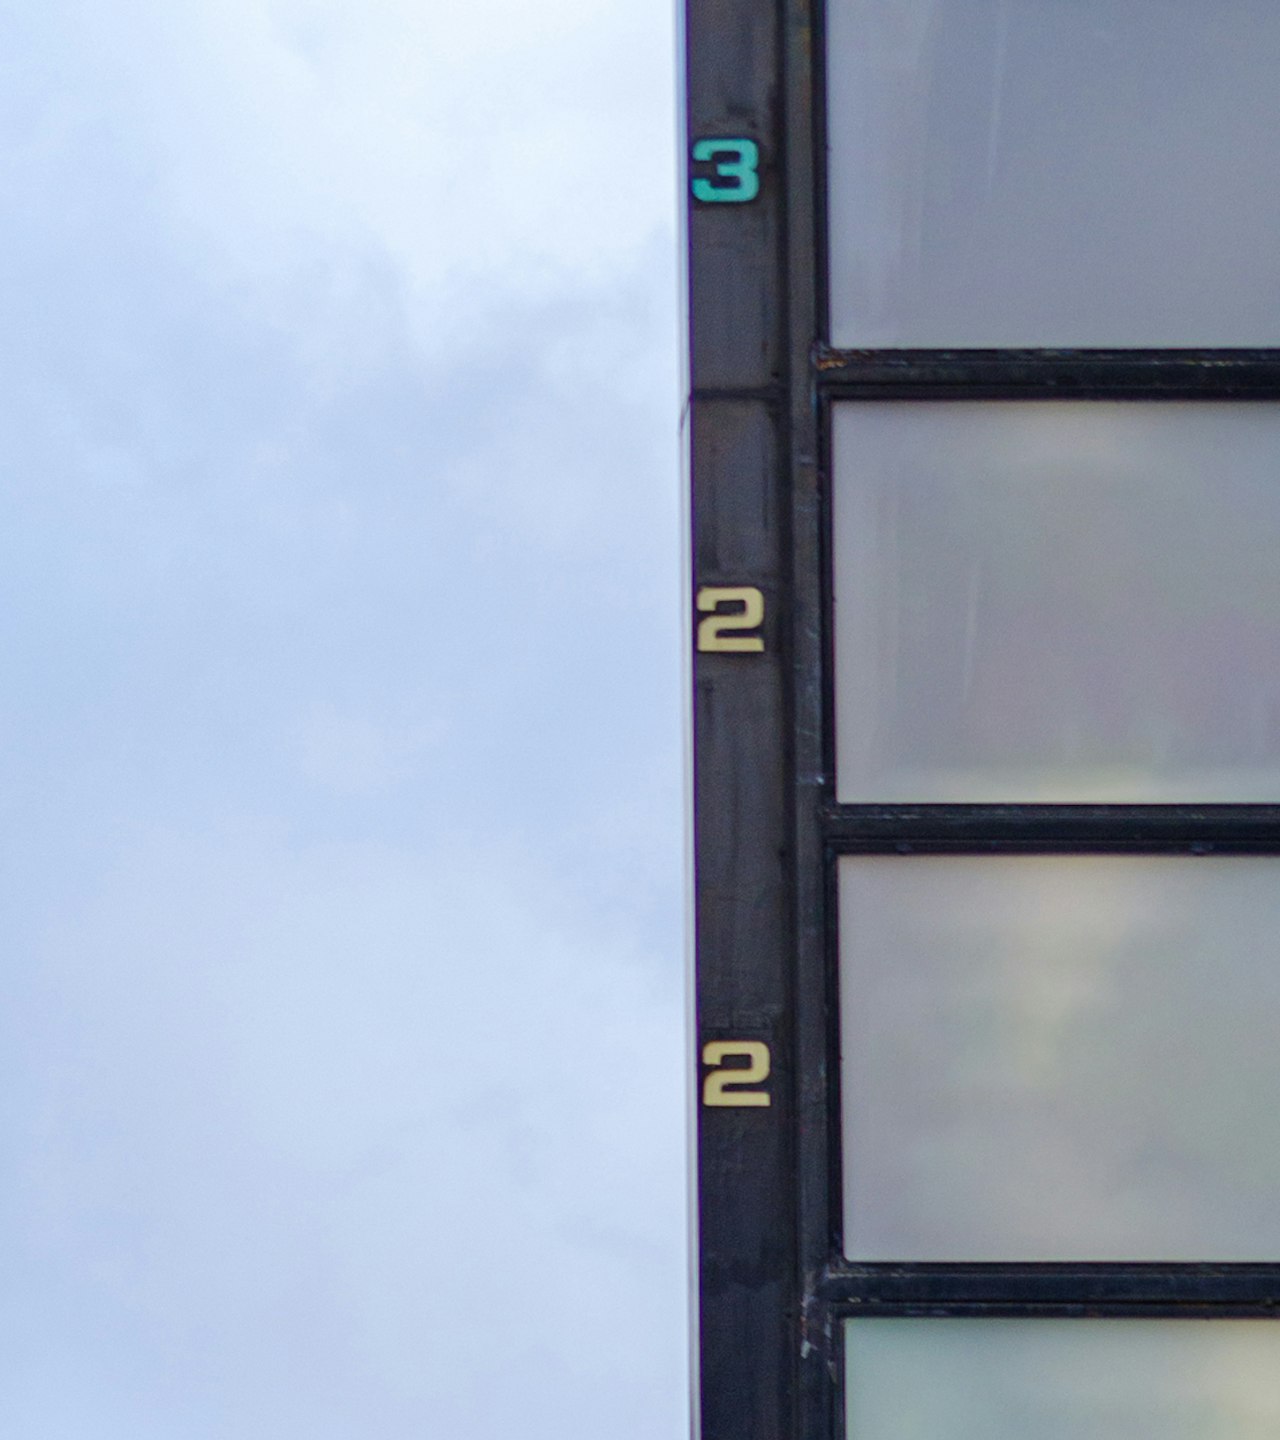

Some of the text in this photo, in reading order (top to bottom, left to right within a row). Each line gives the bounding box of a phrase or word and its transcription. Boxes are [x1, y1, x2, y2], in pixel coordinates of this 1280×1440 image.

[693, 138, 759, 204] 3
[696, 586, 766, 654] 2
[702, 1040, 771, 1107] 2
